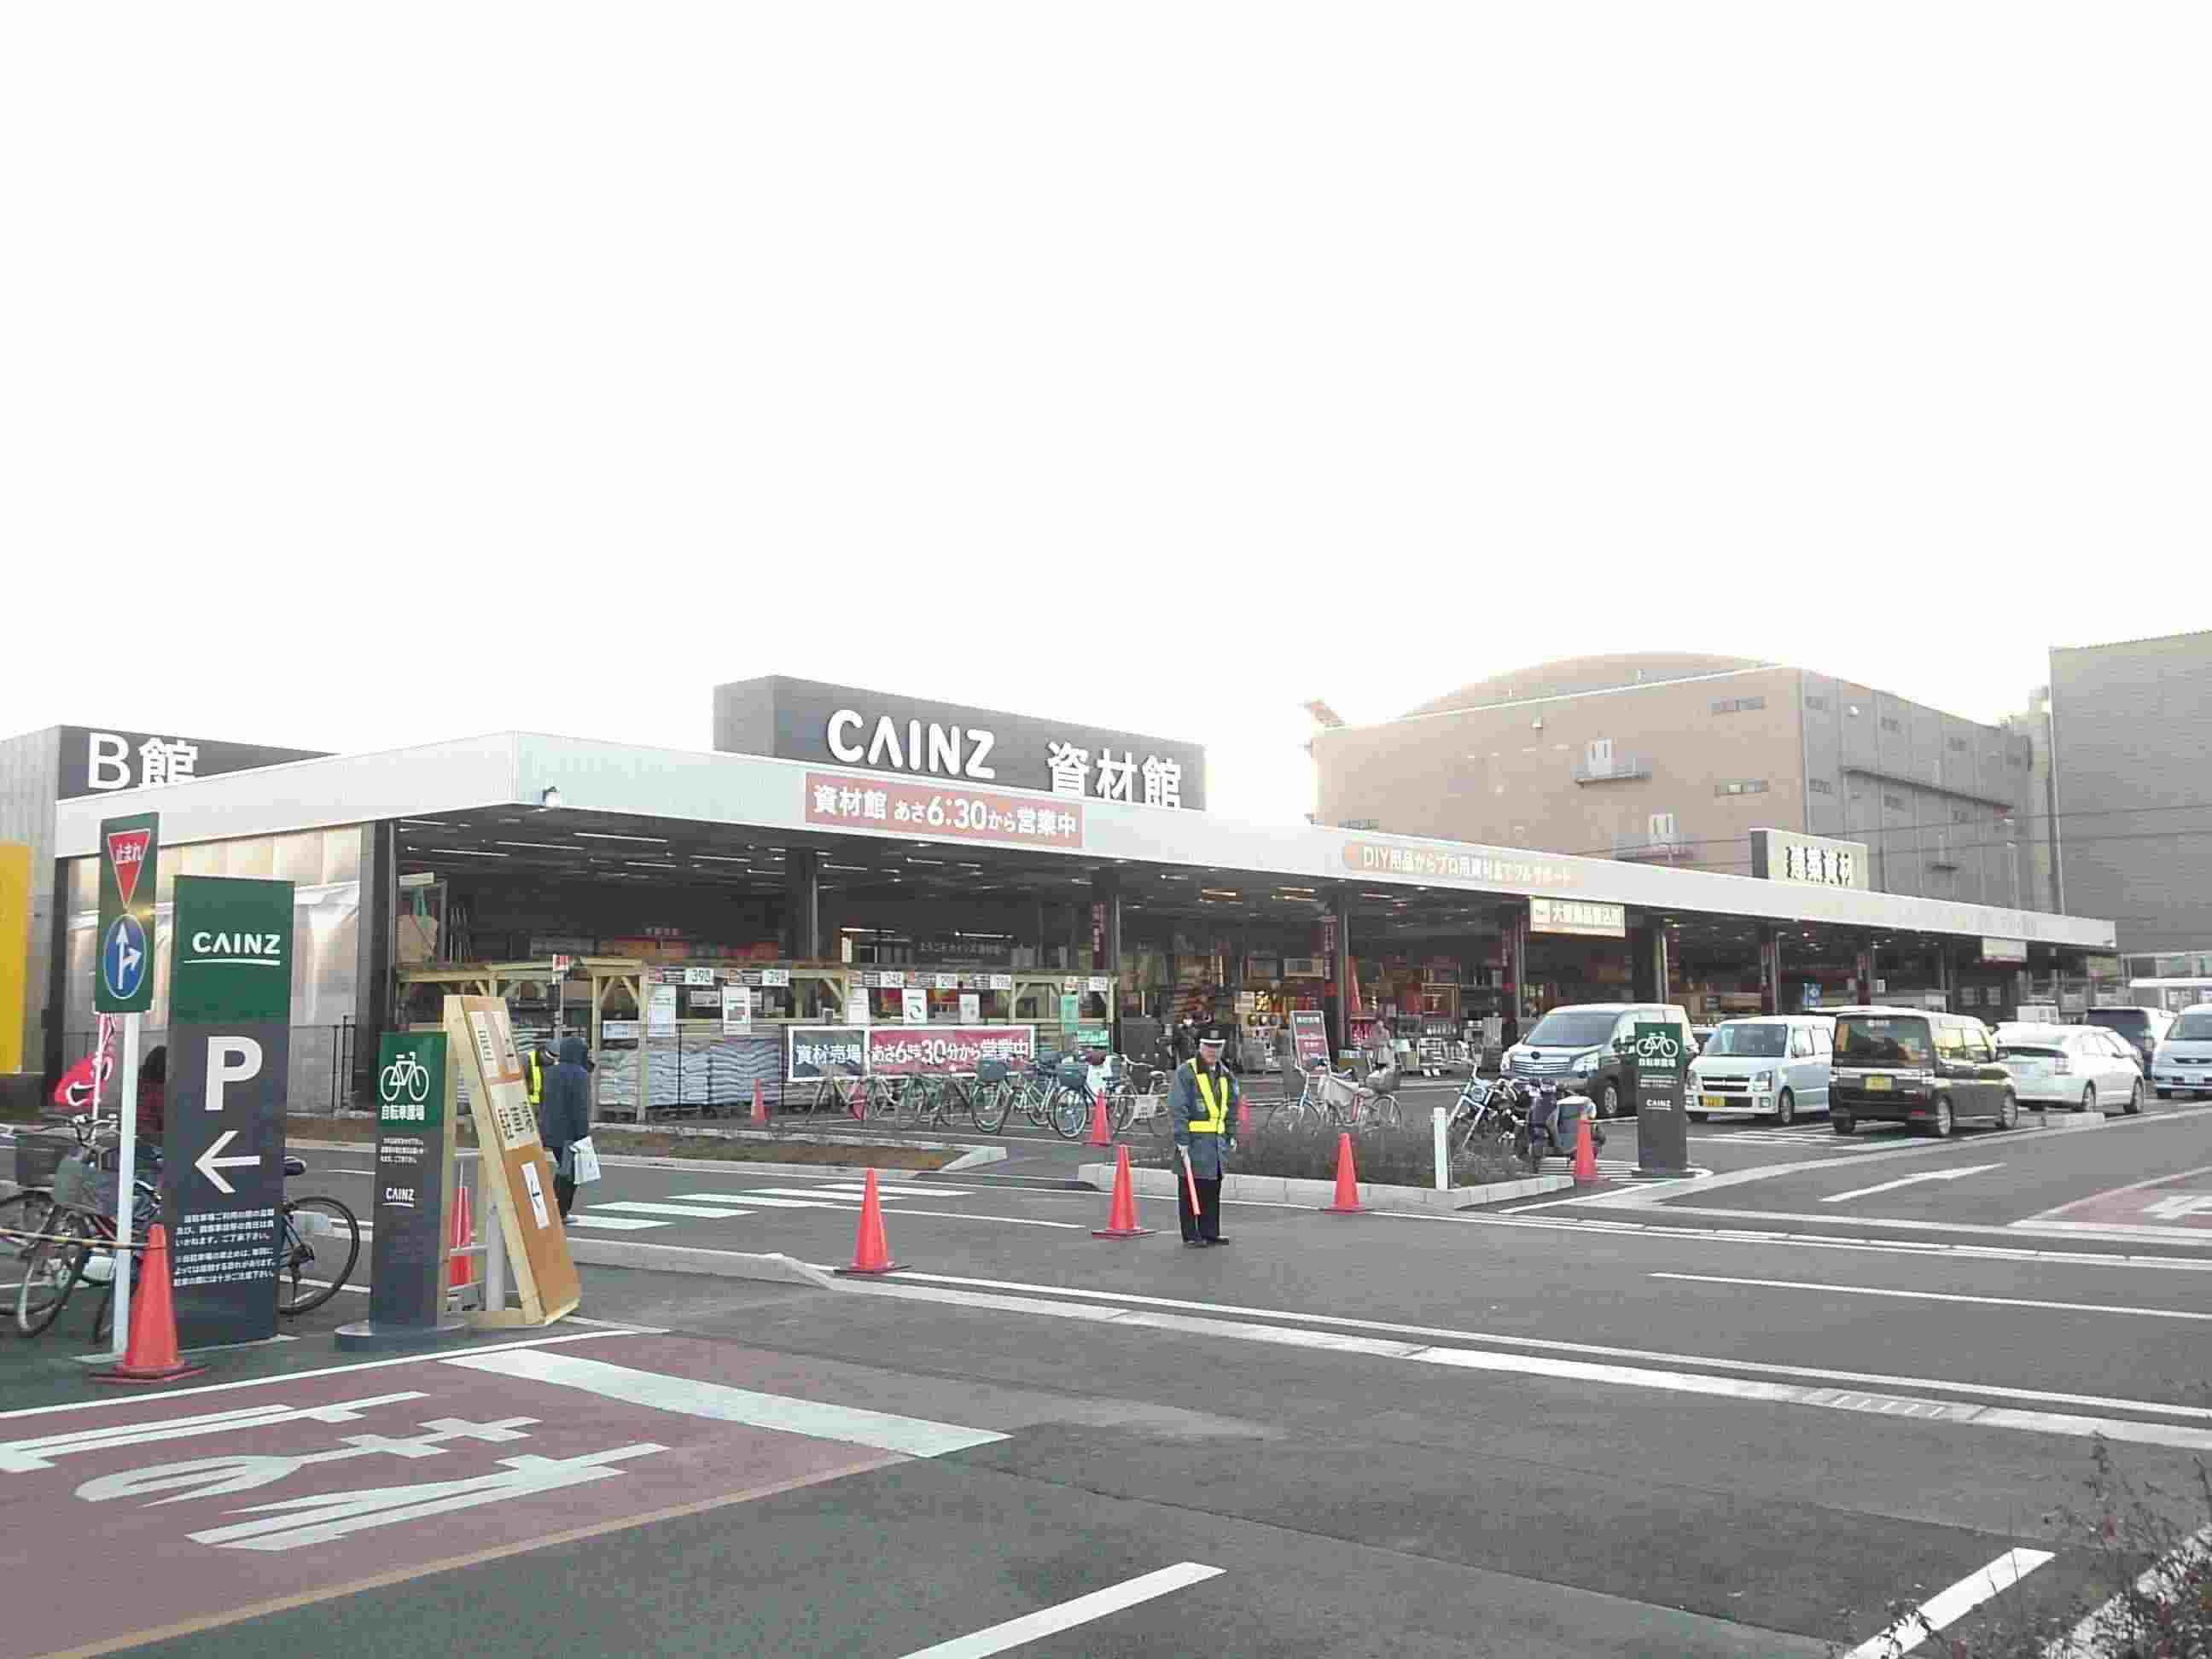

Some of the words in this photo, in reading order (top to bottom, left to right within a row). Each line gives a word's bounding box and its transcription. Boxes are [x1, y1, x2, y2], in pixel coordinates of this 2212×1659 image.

[88, 731, 199, 789] B館
[827, 709, 996, 780] CAINZ
[1045, 742, 1183, 812] 資材館
[813, 784, 888, 821] 資材館
[192, 932, 281, 955] CAINZ
[205, 1035, 263, 1110] P
[795, 1044, 861, 1067] 資材売場
[385, 1187, 416, 1202] CAINZ
